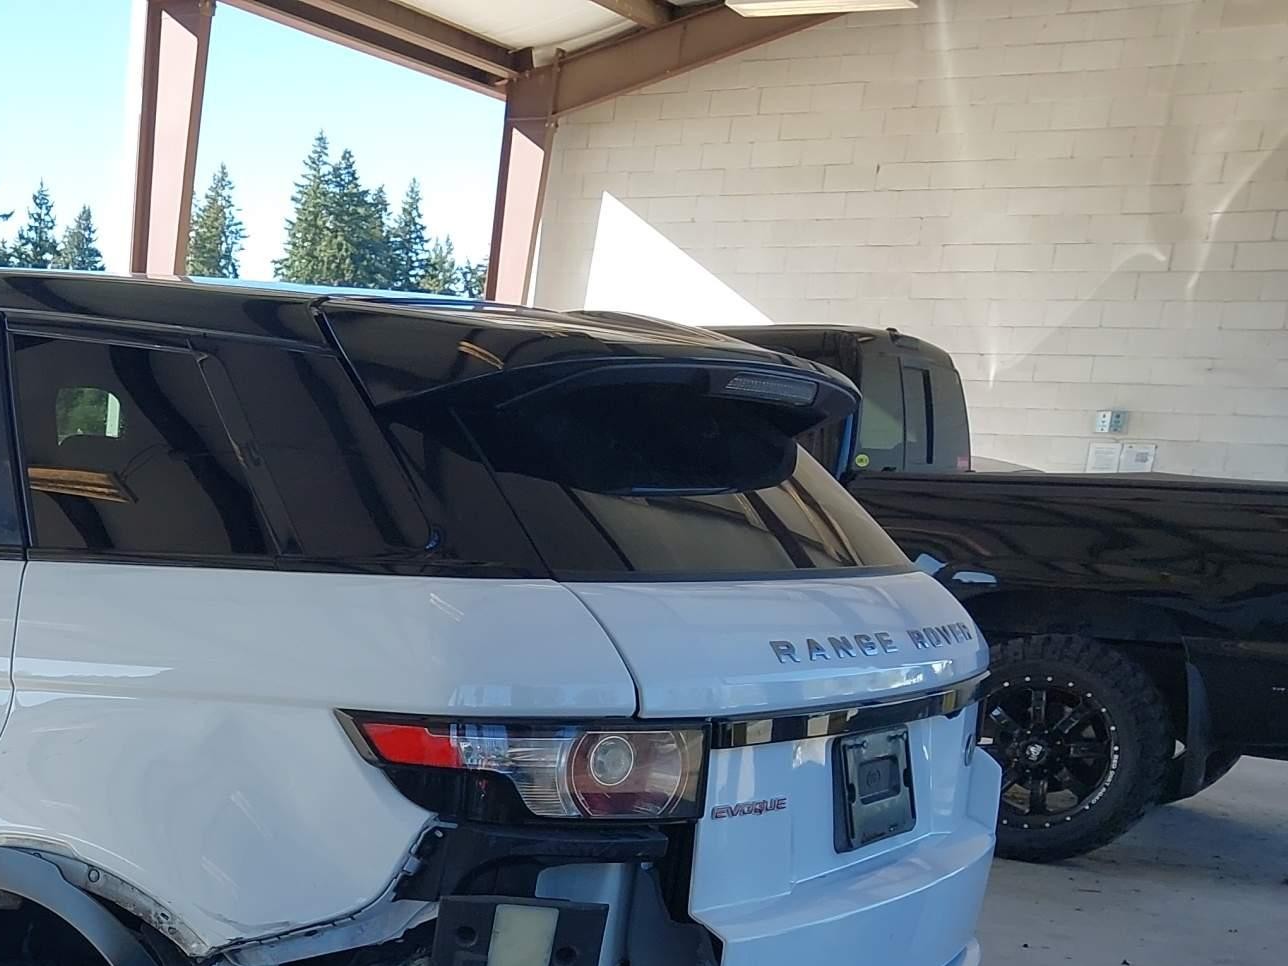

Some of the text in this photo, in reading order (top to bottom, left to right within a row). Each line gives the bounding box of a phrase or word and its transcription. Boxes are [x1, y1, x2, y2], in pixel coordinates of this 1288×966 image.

[769, 622, 972, 663] RANGE ROVER
[712, 798, 787, 820] EVOQUE
